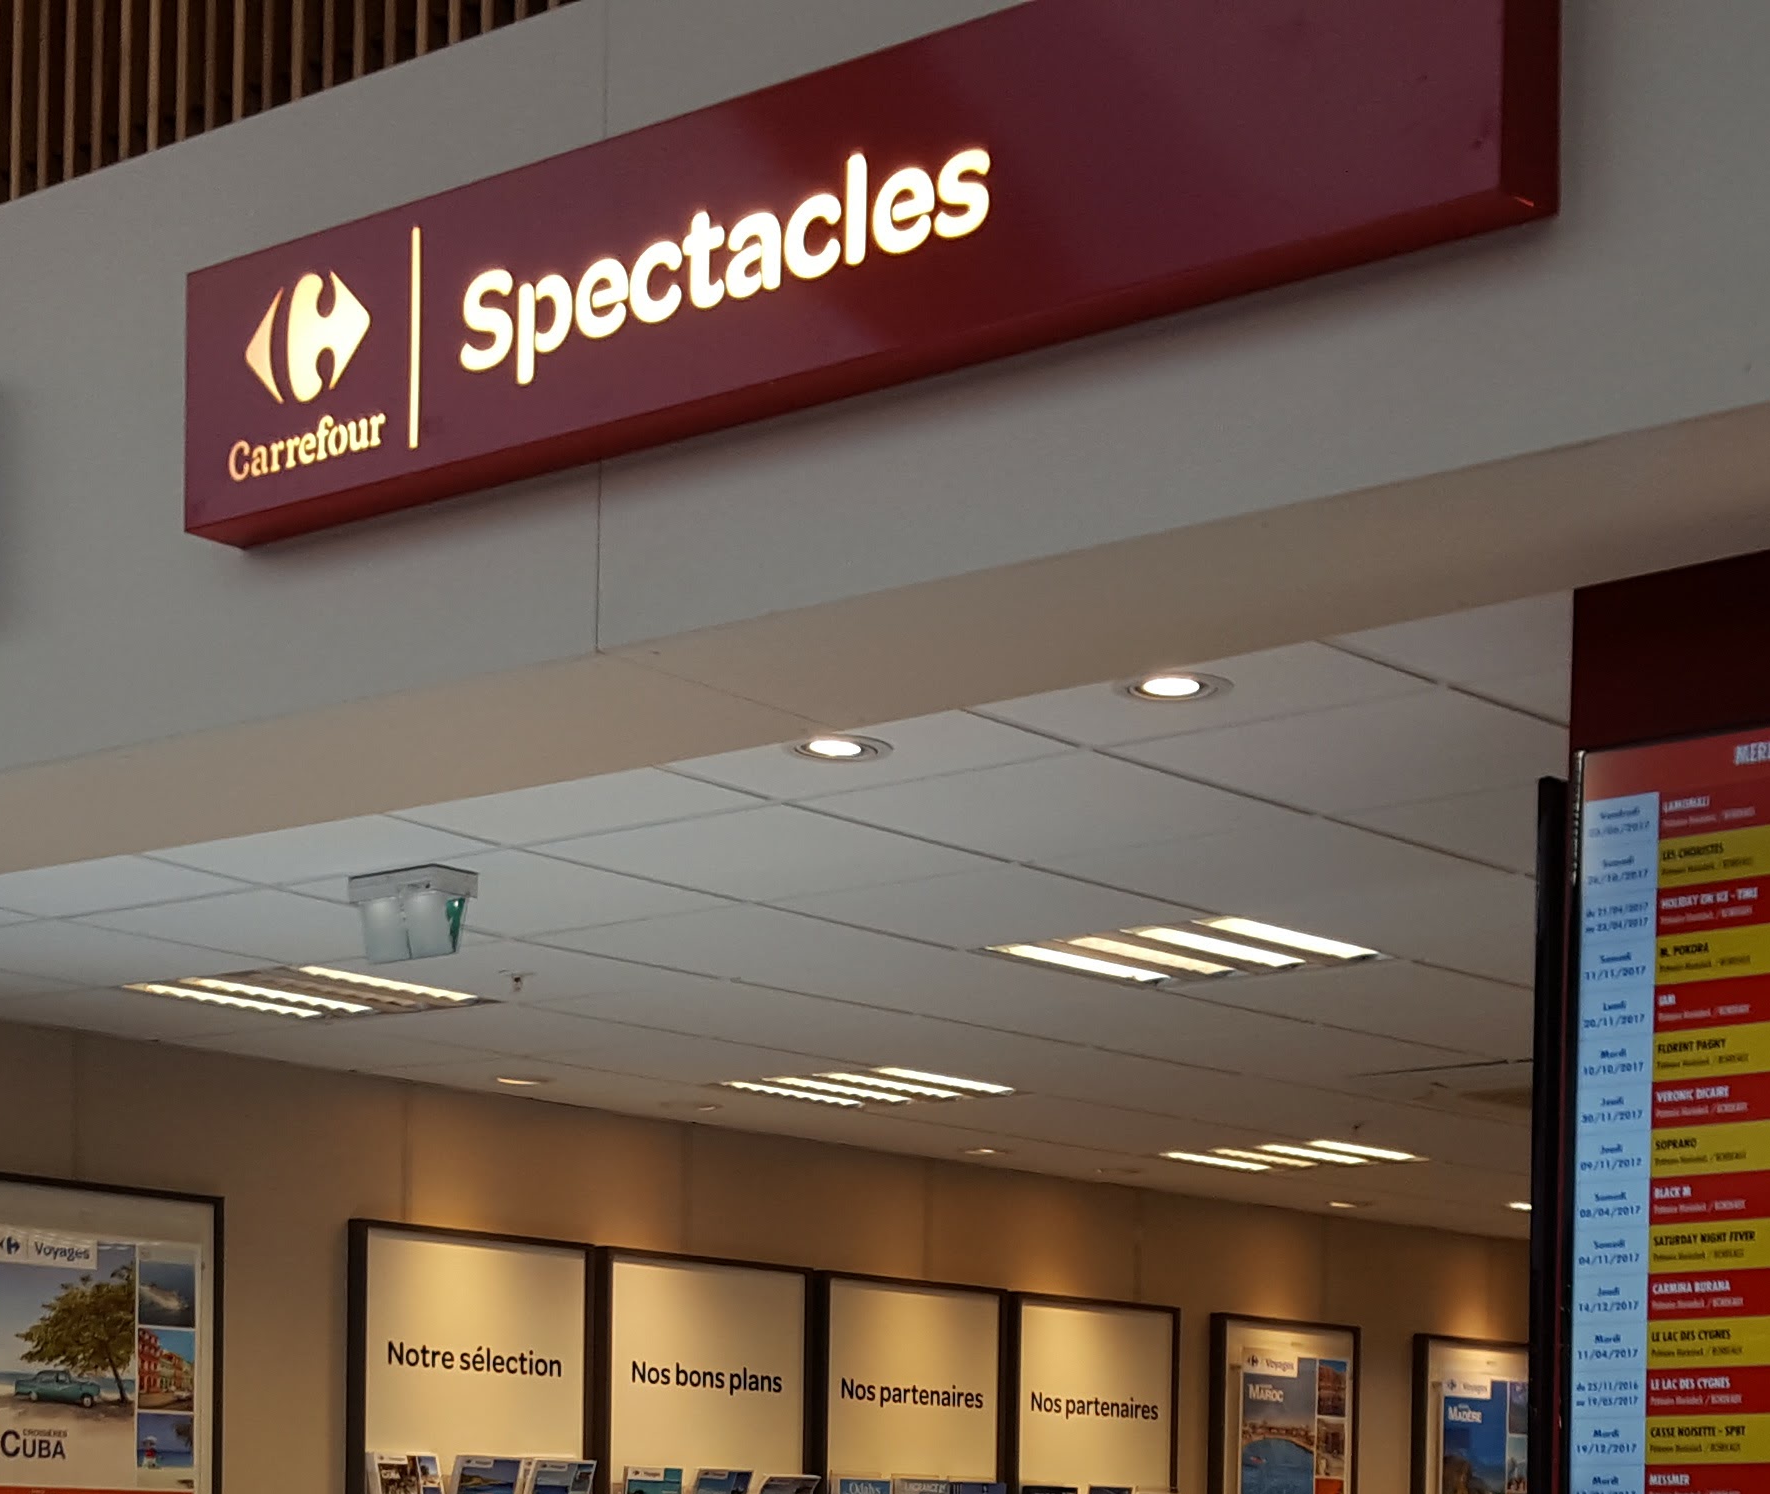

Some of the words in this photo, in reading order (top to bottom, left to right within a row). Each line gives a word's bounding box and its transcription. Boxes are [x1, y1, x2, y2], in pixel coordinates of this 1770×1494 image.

[460, 147, 992, 386] Spectacles
[228, 411, 387, 482] Carrefour
[1584, 965, 1647, 981] 11/11/2017
[1583, 1013, 1645, 1029] 20/11/2017
[1658, 1040, 1694, 1055] FLORENT
[1696, 1037, 1727, 1051] PAGNY
[1600, 1048, 1627, 1059] Mardi
[1583, 1061, 1644, 1076] 10/10/2017
[1600, 1096, 1625, 1107] Jeudi
[1581, 1109, 1643, 1124] 30/11/2017
[1600, 1144, 1624, 1155] Jeudi
[1655, 1137, 1697, 1151] SOPRANO
[1594, 1191, 1627, 1202] Samedi
[1593, 1239, 1626, 1250] Samedi
[1653, 1233, 1698, 1247] SATURDAY
[1700, 1231, 1727, 1244] NIGHT
[1729, 1230, 1756, 1242] FEVER
[34, 1240, 90, 1262] Voyages
[1578, 1253, 1640, 1266] 04/11/2017
[1597, 1286, 1621, 1297] Jeudi
[1652, 1281, 1693, 1295] CARMINA
[1694, 1280, 1731, 1292] BURANA
[1578, 1300, 1639, 1314] 14/12/2017
[1594, 1334, 1621, 1345] Mardi
[1651, 1331, 1661, 1342] LE
[1663, 1330, 1678, 1342] LAC
[1680, 1329, 1696, 1341] DES
[1698, 1328, 1731, 1340] CYGNES
[387, 1340, 455, 1371] Notre
[459, 1343, 562, 1378] sélection
[1578, 1348, 1639, 1361] 11/04/2017
[631, 1360, 671, 1387] Nos
[675, 1362, 726, 1391] bons
[729, 1366, 783, 1396] plans
[1650, 1379, 1660, 1391] LE
[1662, 1378, 1678, 1390] LAC
[1679, 1377, 1695, 1389] DES
[1697, 1376, 1731, 1389] CYGNES
[841, 1376, 876, 1402] Nos
[879, 1383, 984, 1409] partenaires
[1248, 1384, 1284, 1403] MAROC
[1030, 1390, 1063, 1415] Nos
[1065, 1395, 1160, 1421] partenaires
[1592, 1429, 1620, 1438] Mardi
[1650, 1426, 1676, 1438] CASSE
[1677, 1425, 1716, 1437] NOISETTE
[0, 1429, 66, 1460] CUBA
[1576, 1443, 1637, 1455] 19/12/2017
[1592, 1476, 1620, 1486] Mardi
[1649, 1473, 1690, 1486] MESSMER
